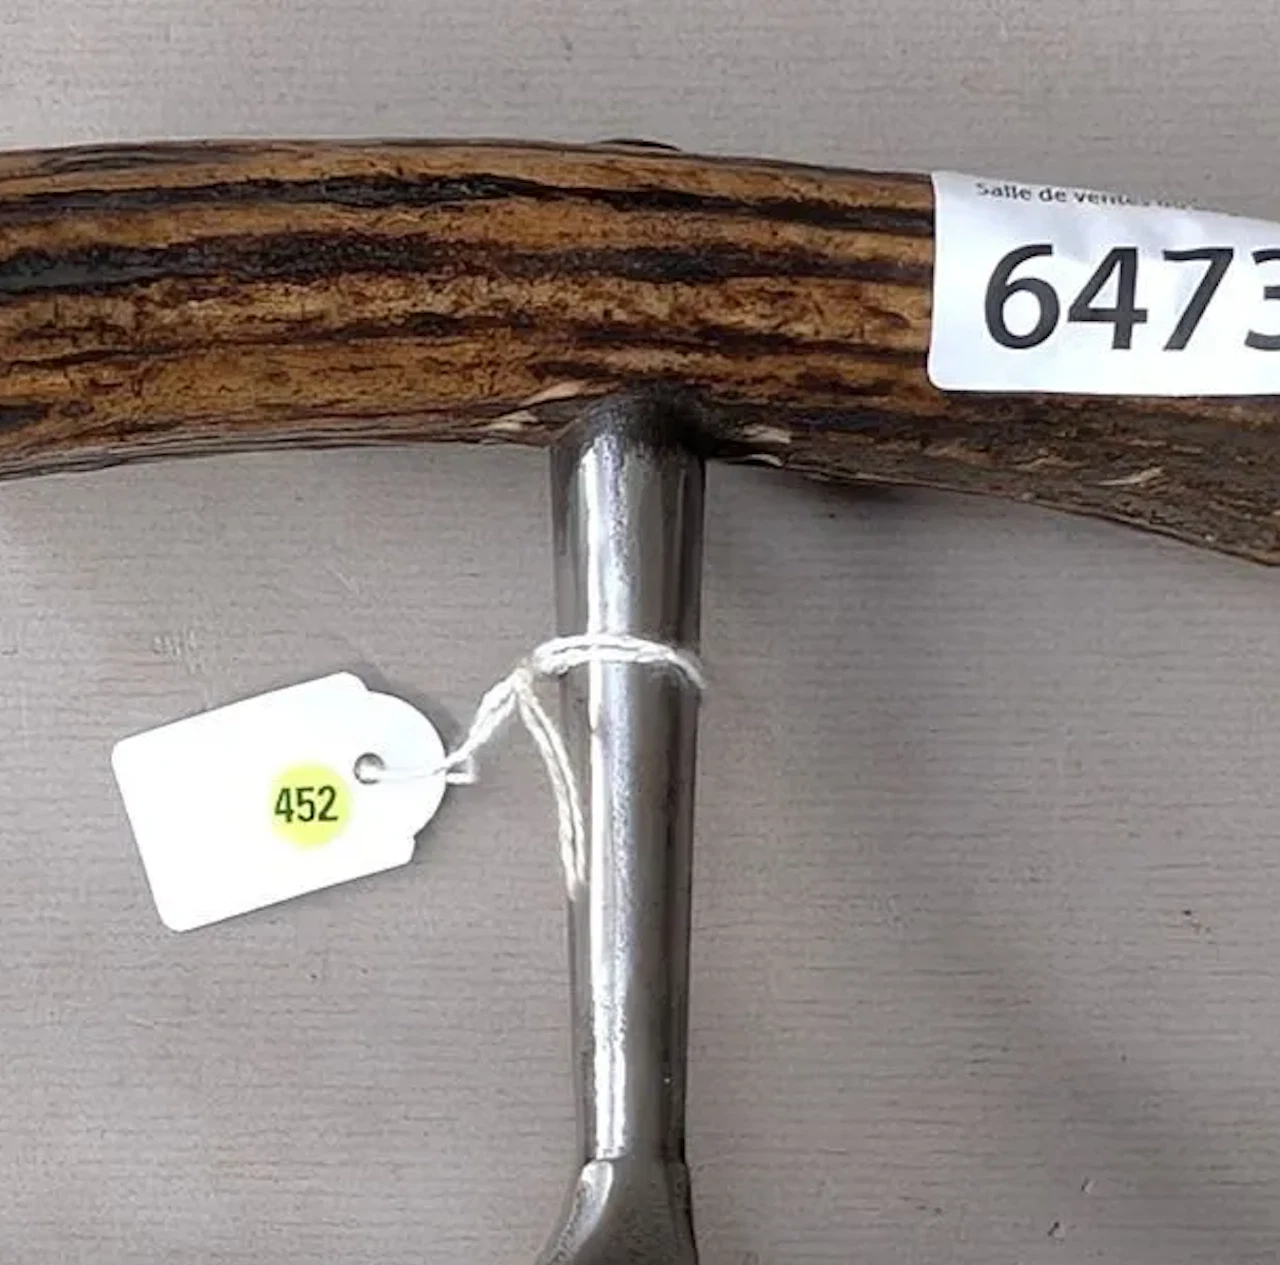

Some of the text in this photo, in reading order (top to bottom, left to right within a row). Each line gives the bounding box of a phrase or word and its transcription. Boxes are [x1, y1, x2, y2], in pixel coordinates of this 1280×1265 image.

[976, 182, 1032, 201] Salle
[1039, 186, 1067, 203] de
[274, 785, 339, 822] 452
